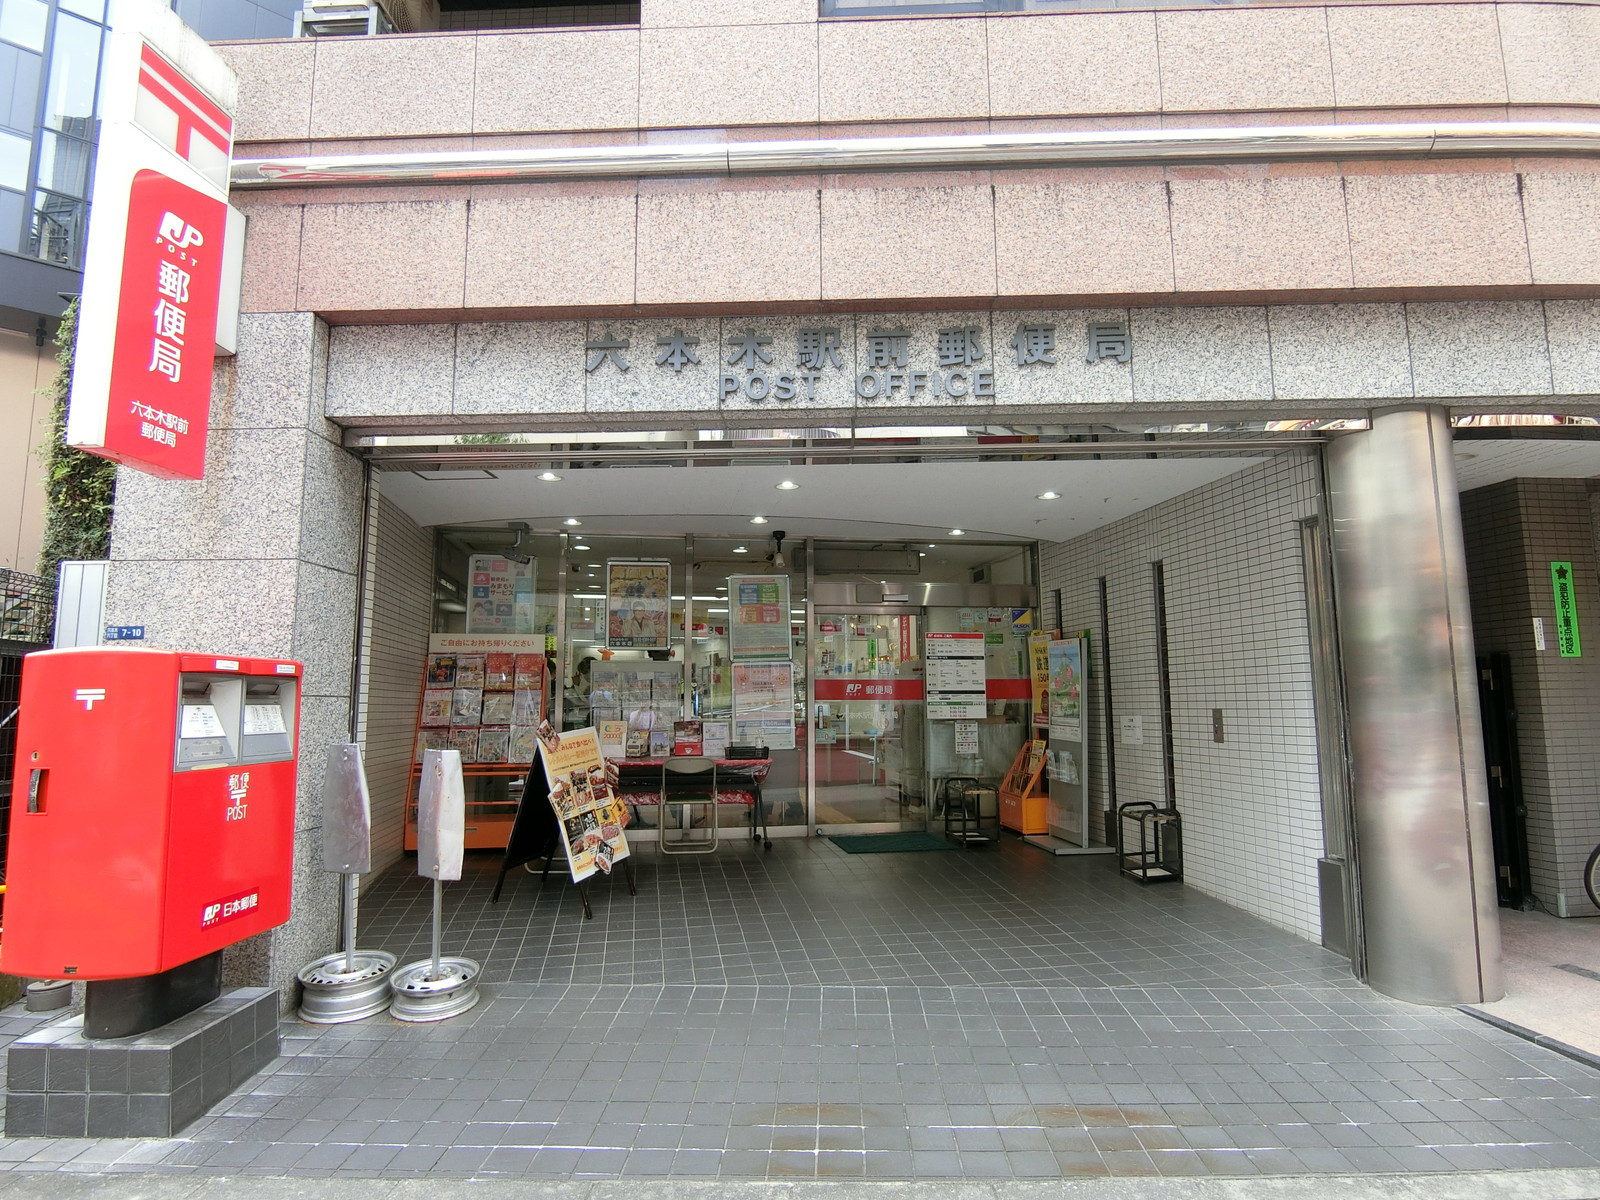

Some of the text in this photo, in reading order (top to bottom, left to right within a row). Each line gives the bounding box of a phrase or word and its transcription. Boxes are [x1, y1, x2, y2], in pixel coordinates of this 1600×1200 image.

[155, 236, 198, 267] POST
[149, 259, 191, 383] 郵便局
[586, 322, 1132, 372] 六本木駅前郵便局
[719, 369, 995, 401] POST OFFICE
[131, 400, 189, 435] 六本木駅前
[141, 421, 176, 448] 郵便局
[1559, 582, 1574, 654] 盗犯防止重点地区
[122, 629, 141, 637] 7-10
[440, 639, 535, 648] ご自由にお持ち帰りください
[865, 685, 893, 695] 郵便局
[229, 772, 250, 790] 郵便
[226, 804, 248, 821] POST
[223, 893, 258, 917] 日本郵便
